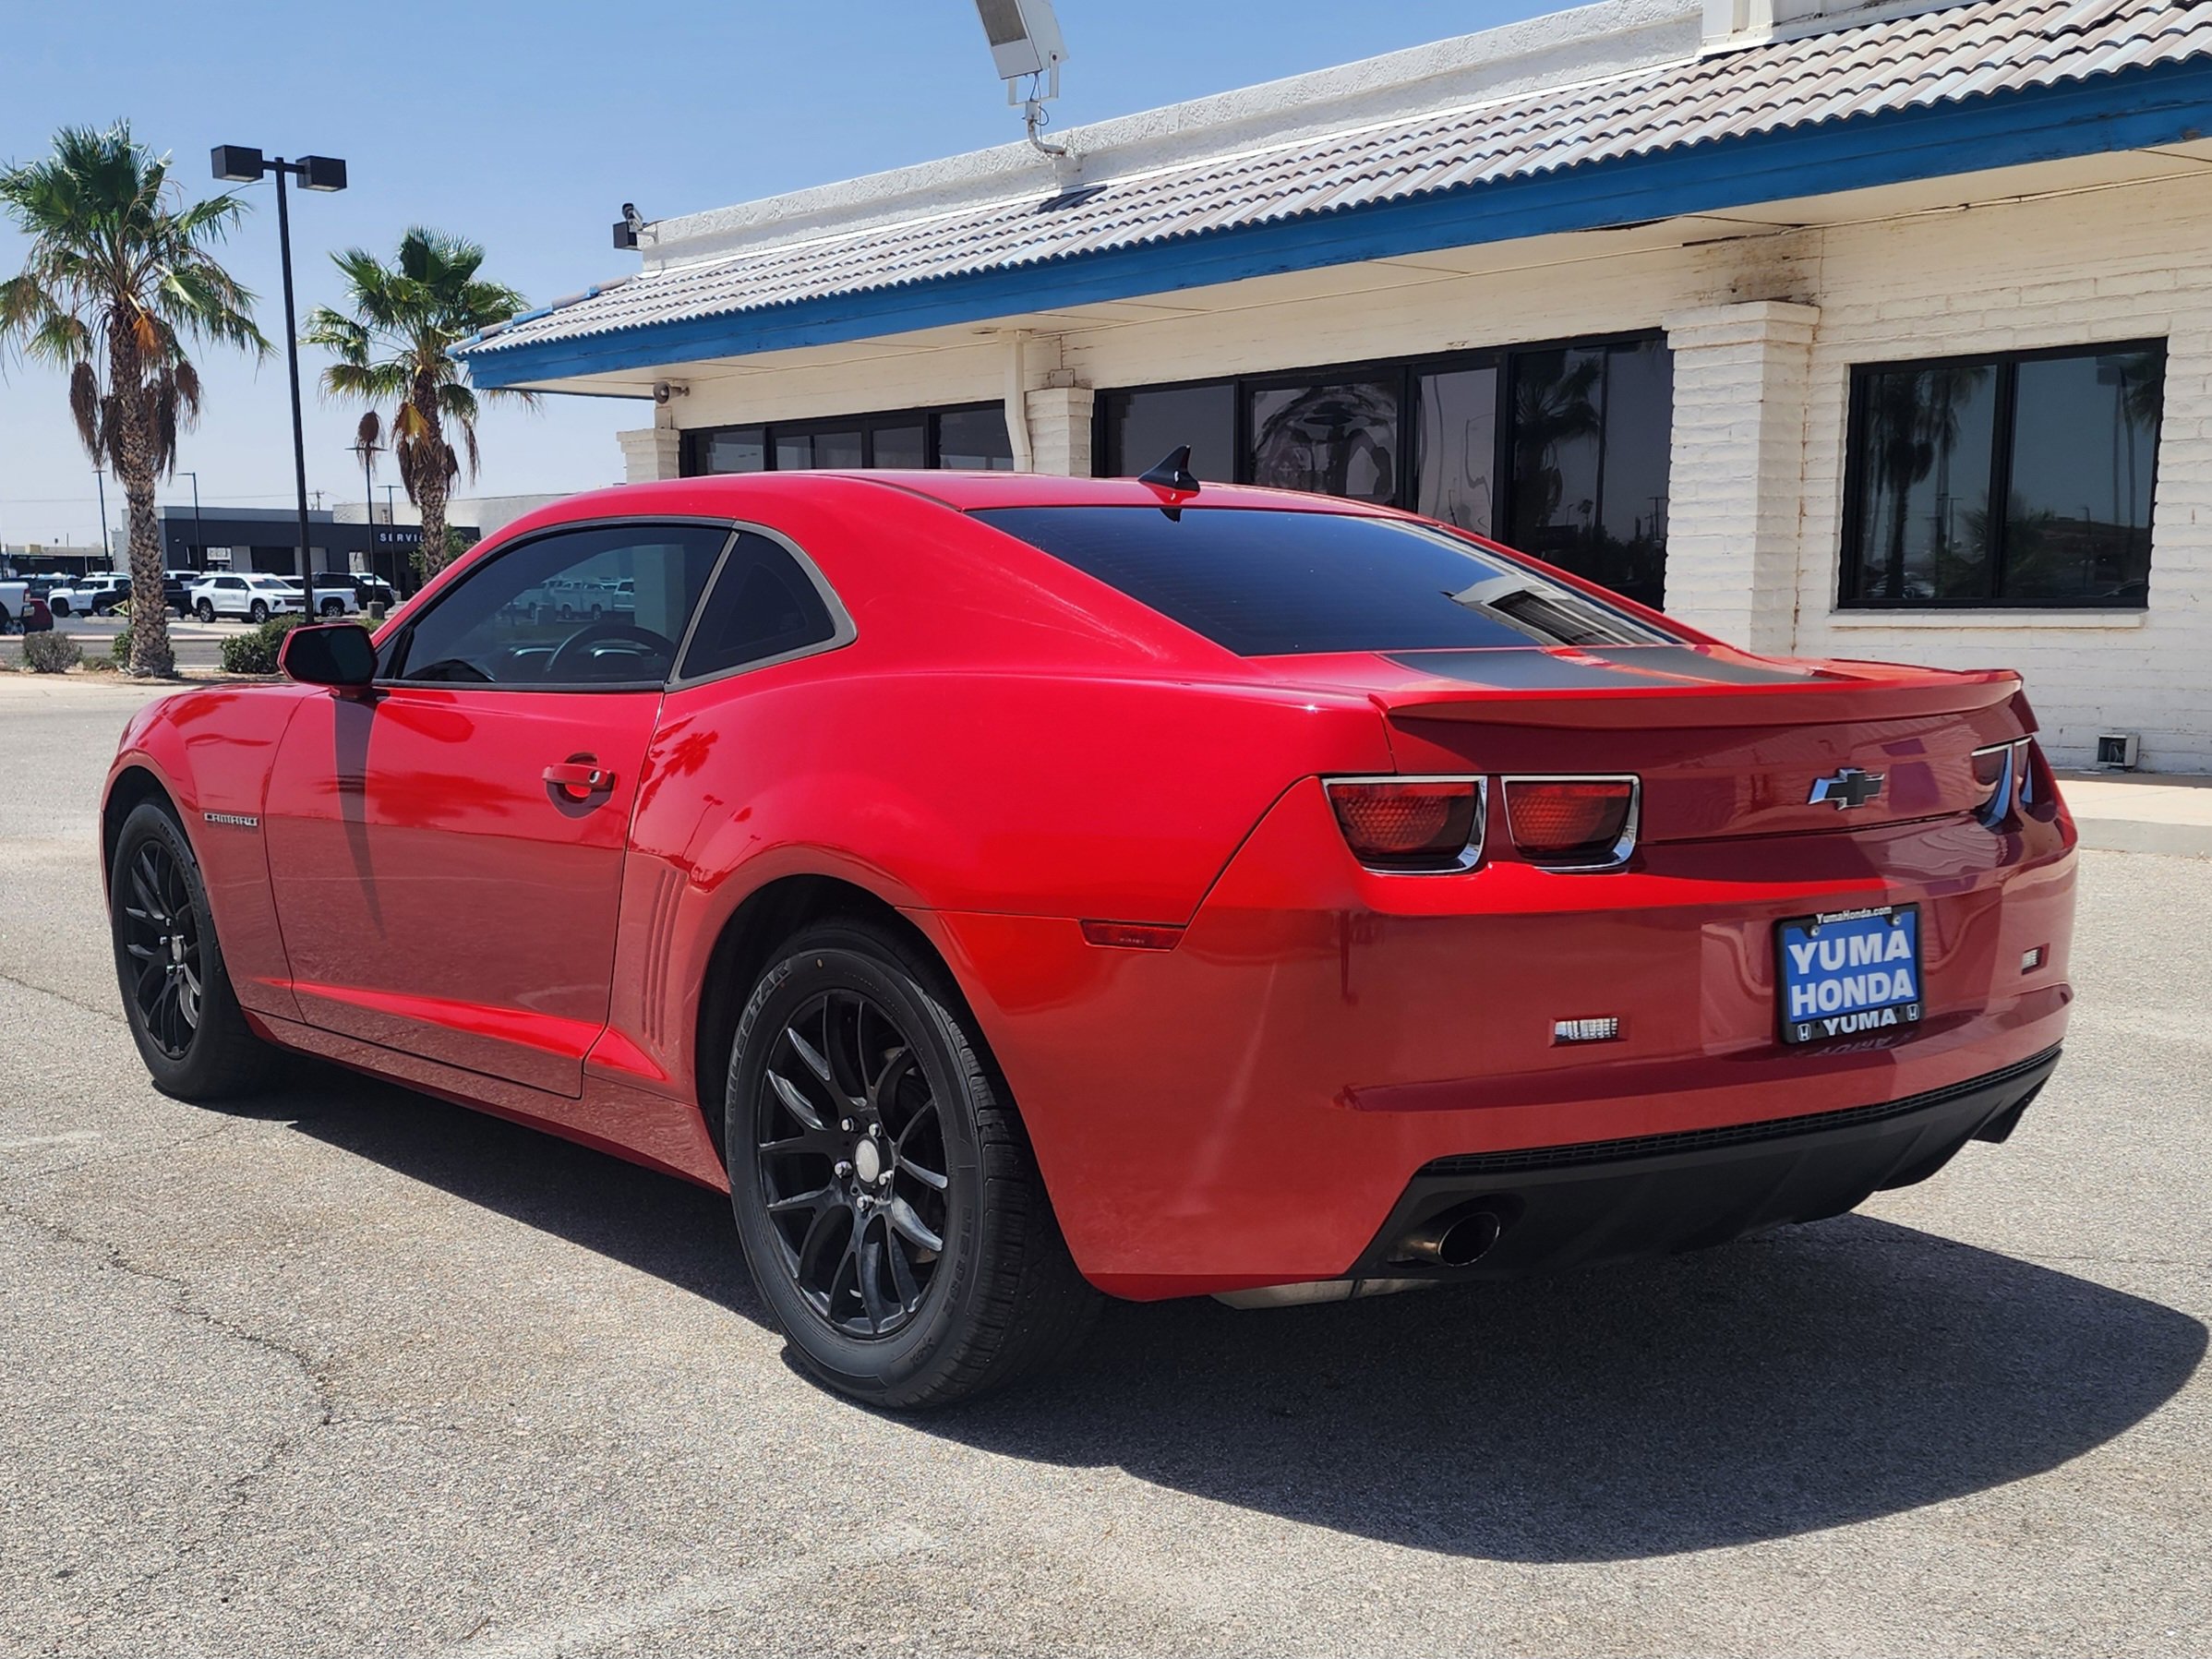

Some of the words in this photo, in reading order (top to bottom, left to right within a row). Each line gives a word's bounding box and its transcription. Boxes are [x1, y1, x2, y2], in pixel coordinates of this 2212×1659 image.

[204, 812, 258, 826] CAMARO
[1816, 906, 1893, 924] YumaHonda.com
[1788, 930, 1911, 975] YUMA
[1791, 968, 1915, 1017] HONDA
[1822, 1008, 1897, 1036] YUMA
